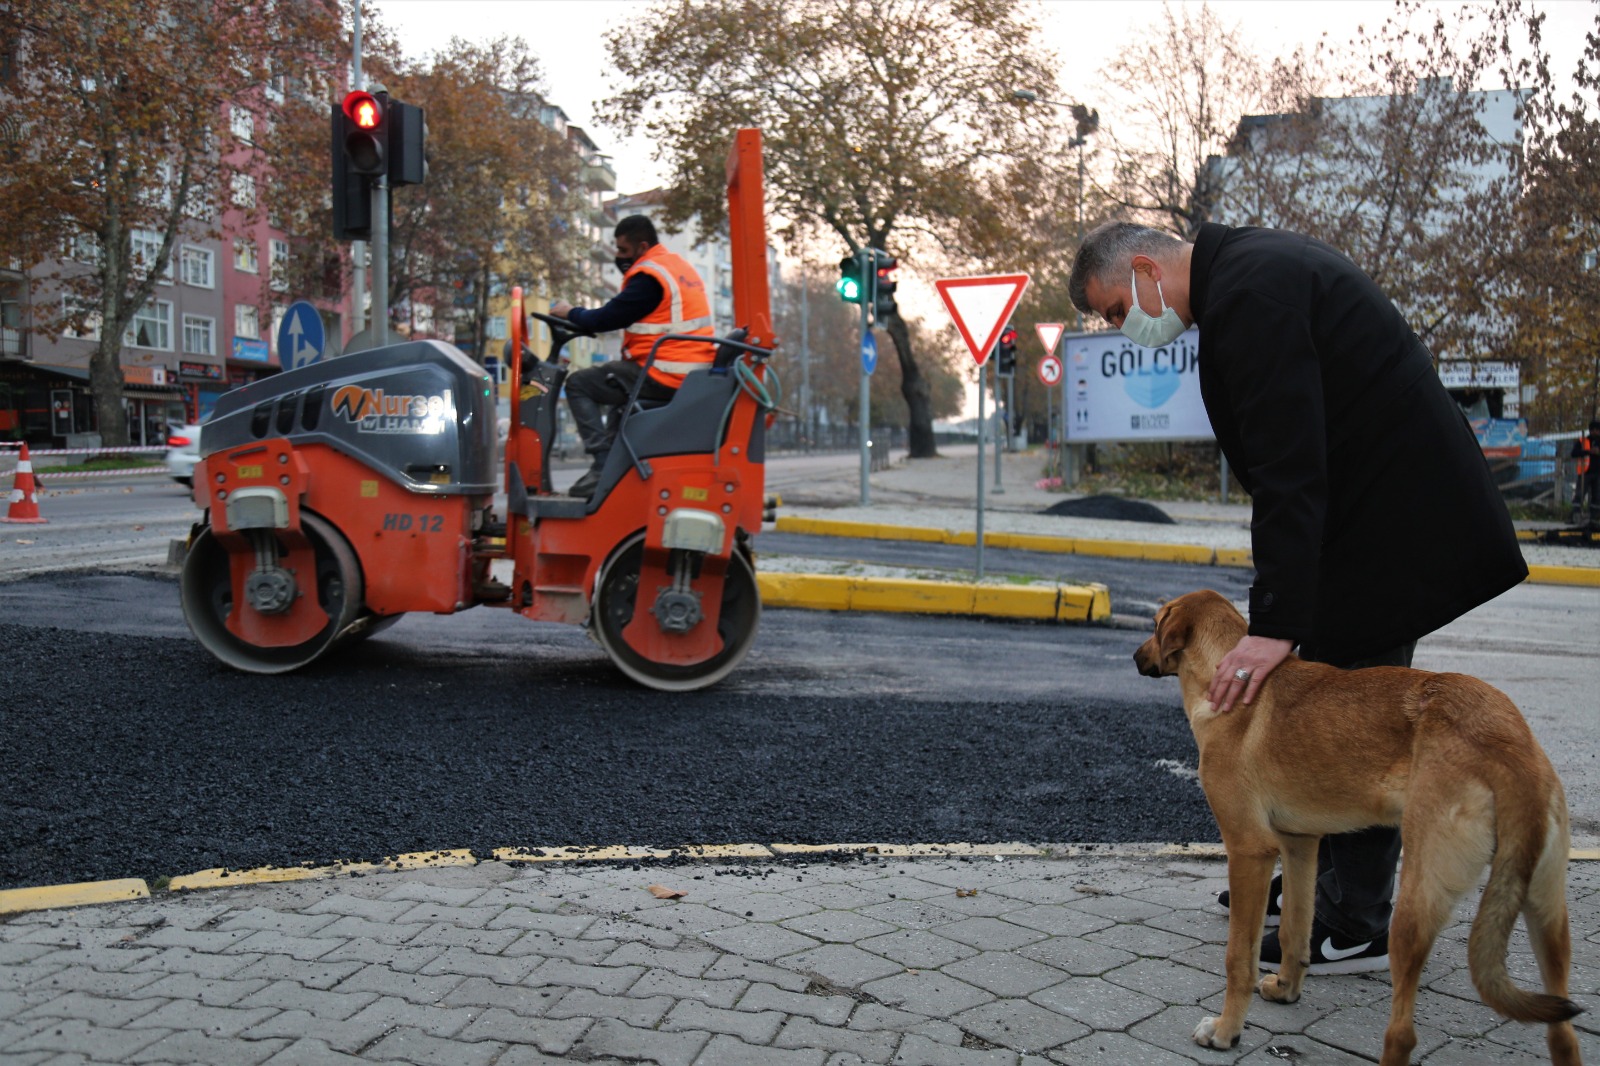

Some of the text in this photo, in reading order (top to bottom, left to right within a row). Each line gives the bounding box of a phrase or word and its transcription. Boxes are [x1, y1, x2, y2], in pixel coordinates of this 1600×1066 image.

[363, 388, 452, 417] Nursel
[385, 418, 445, 434] HAM
[383, 513, 445, 533] HD 12
